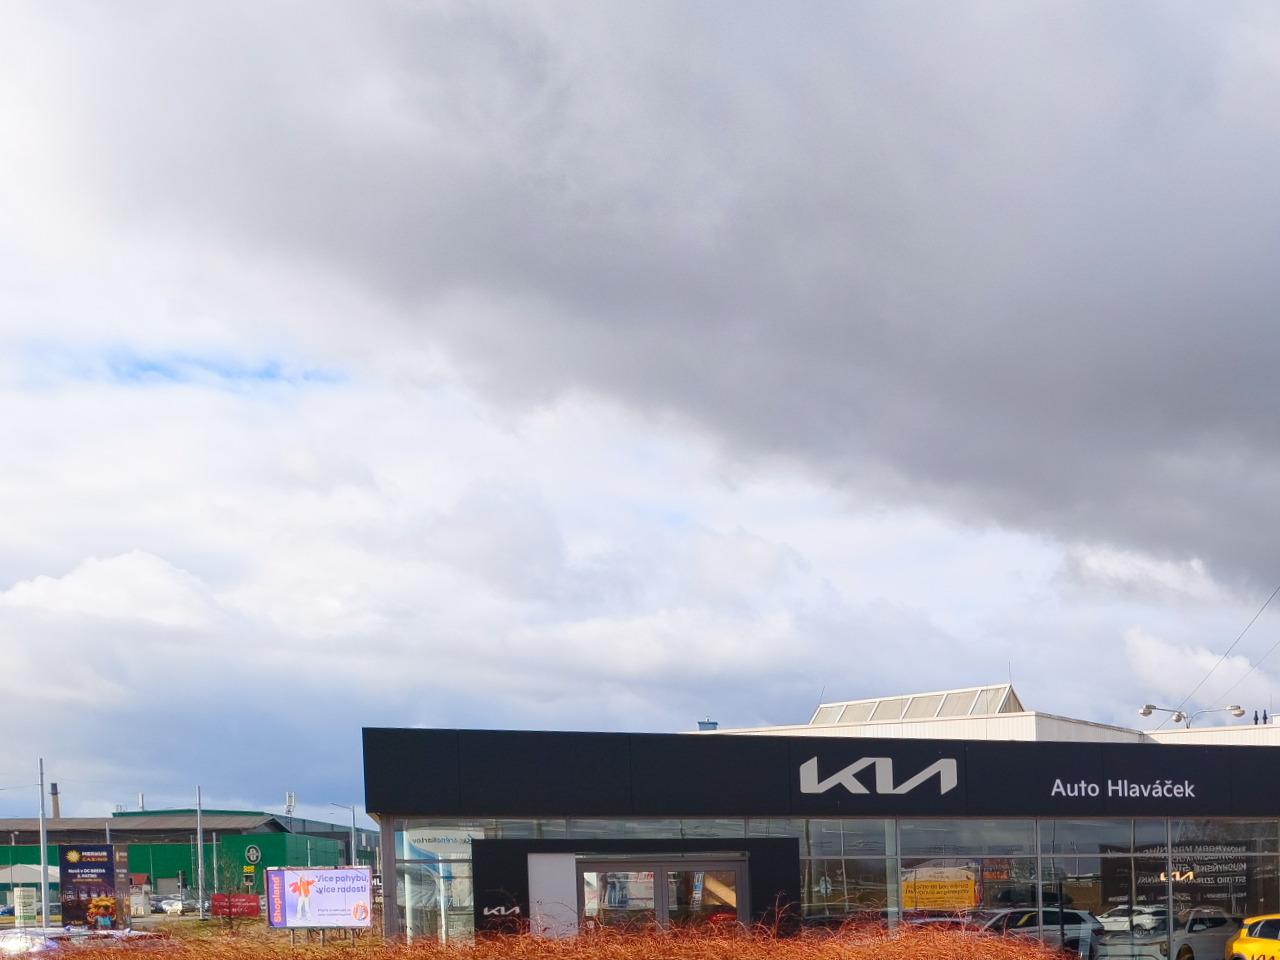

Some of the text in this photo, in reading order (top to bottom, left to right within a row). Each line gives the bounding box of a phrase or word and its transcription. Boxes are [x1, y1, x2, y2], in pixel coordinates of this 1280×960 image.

[800, 756, 958, 795] KIA
[1051, 778, 1196, 798] Auto Hlaváček
[337, 884, 367, 893] radosti
[272, 875, 282, 923] Shopland
[483, 906, 520, 915] KIA
